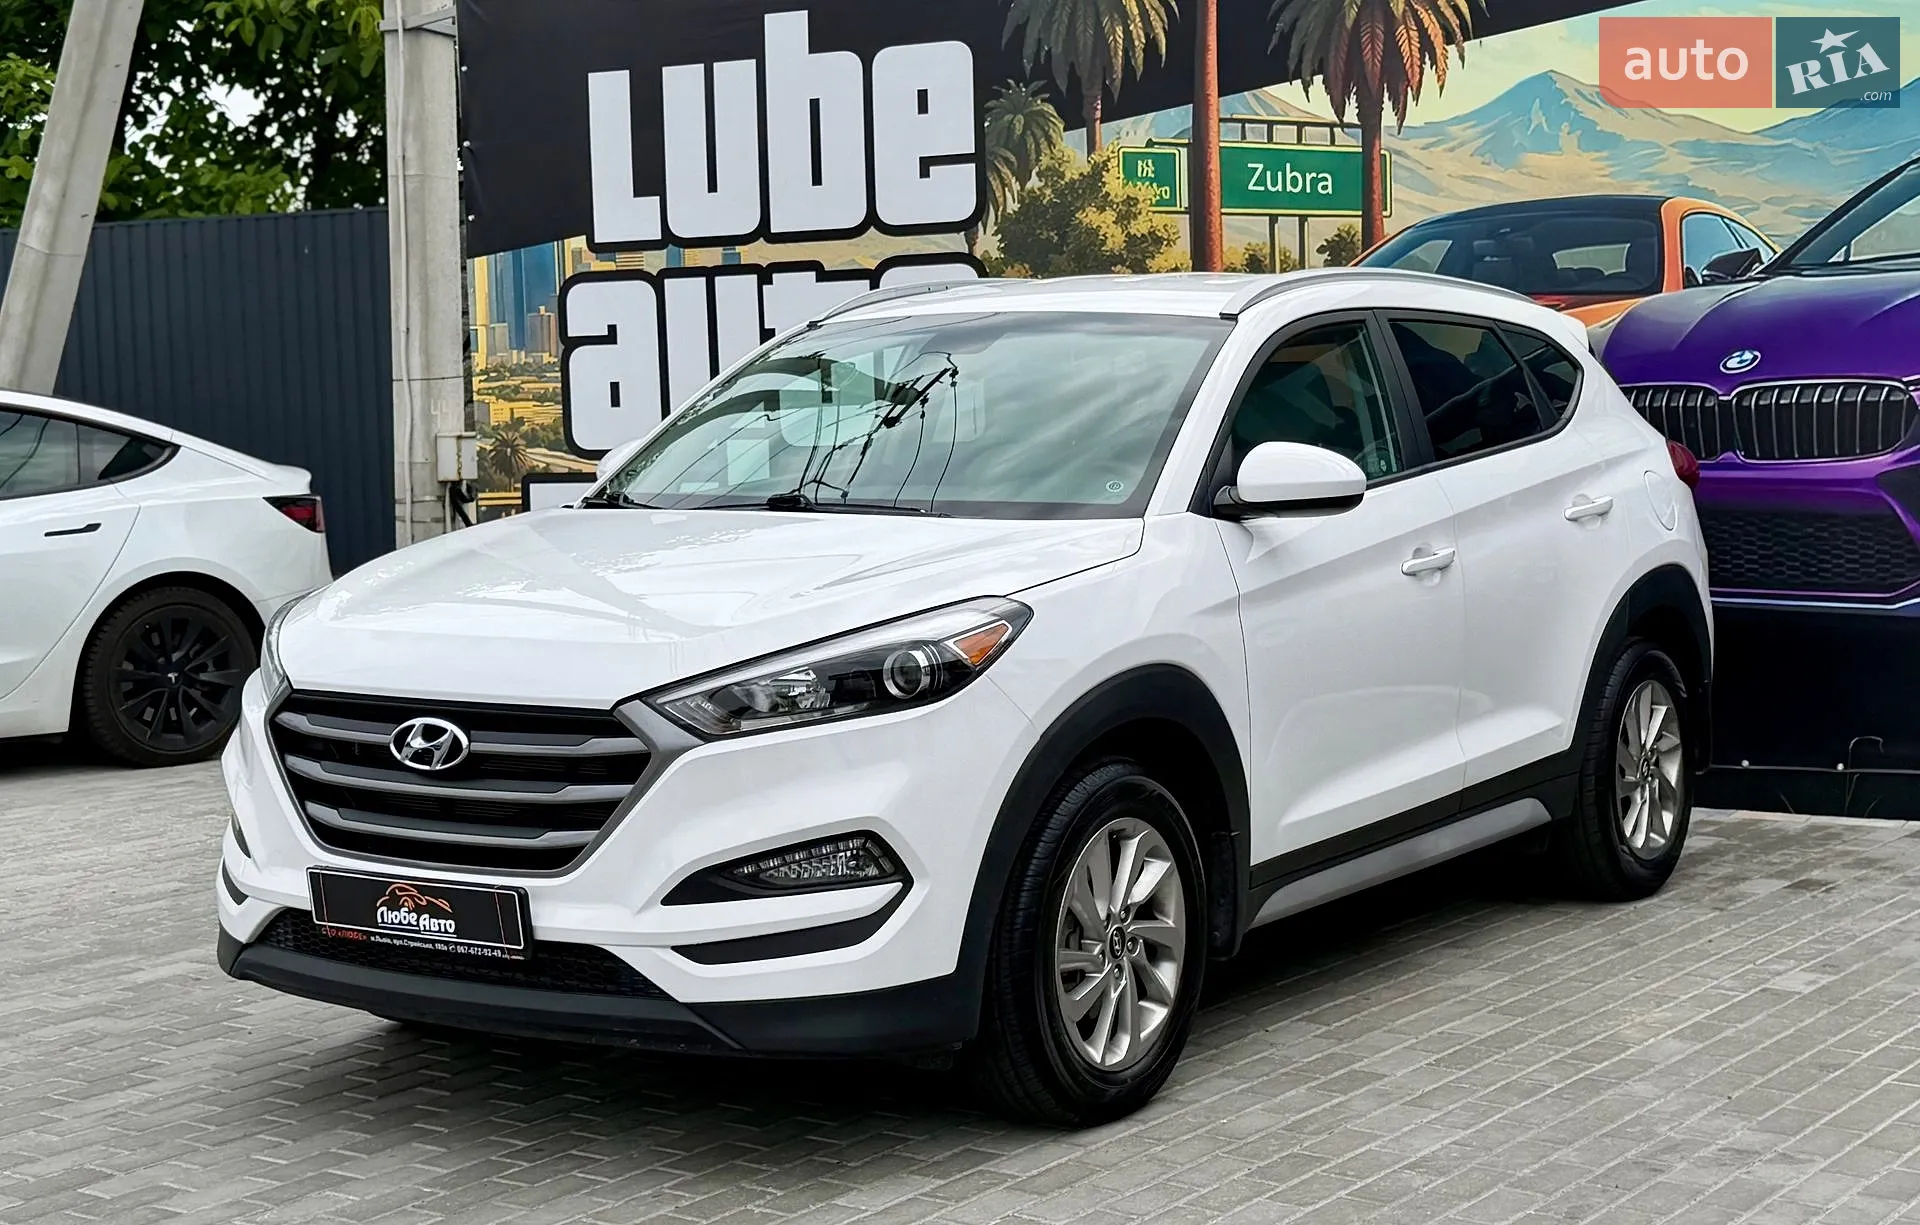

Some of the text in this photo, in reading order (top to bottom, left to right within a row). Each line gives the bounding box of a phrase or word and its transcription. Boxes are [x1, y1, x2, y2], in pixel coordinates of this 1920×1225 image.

[587, 9, 977, 244] Lube
[1246, 162, 1334, 195] Zubra
[376, 906, 456, 933] Любе Авто
